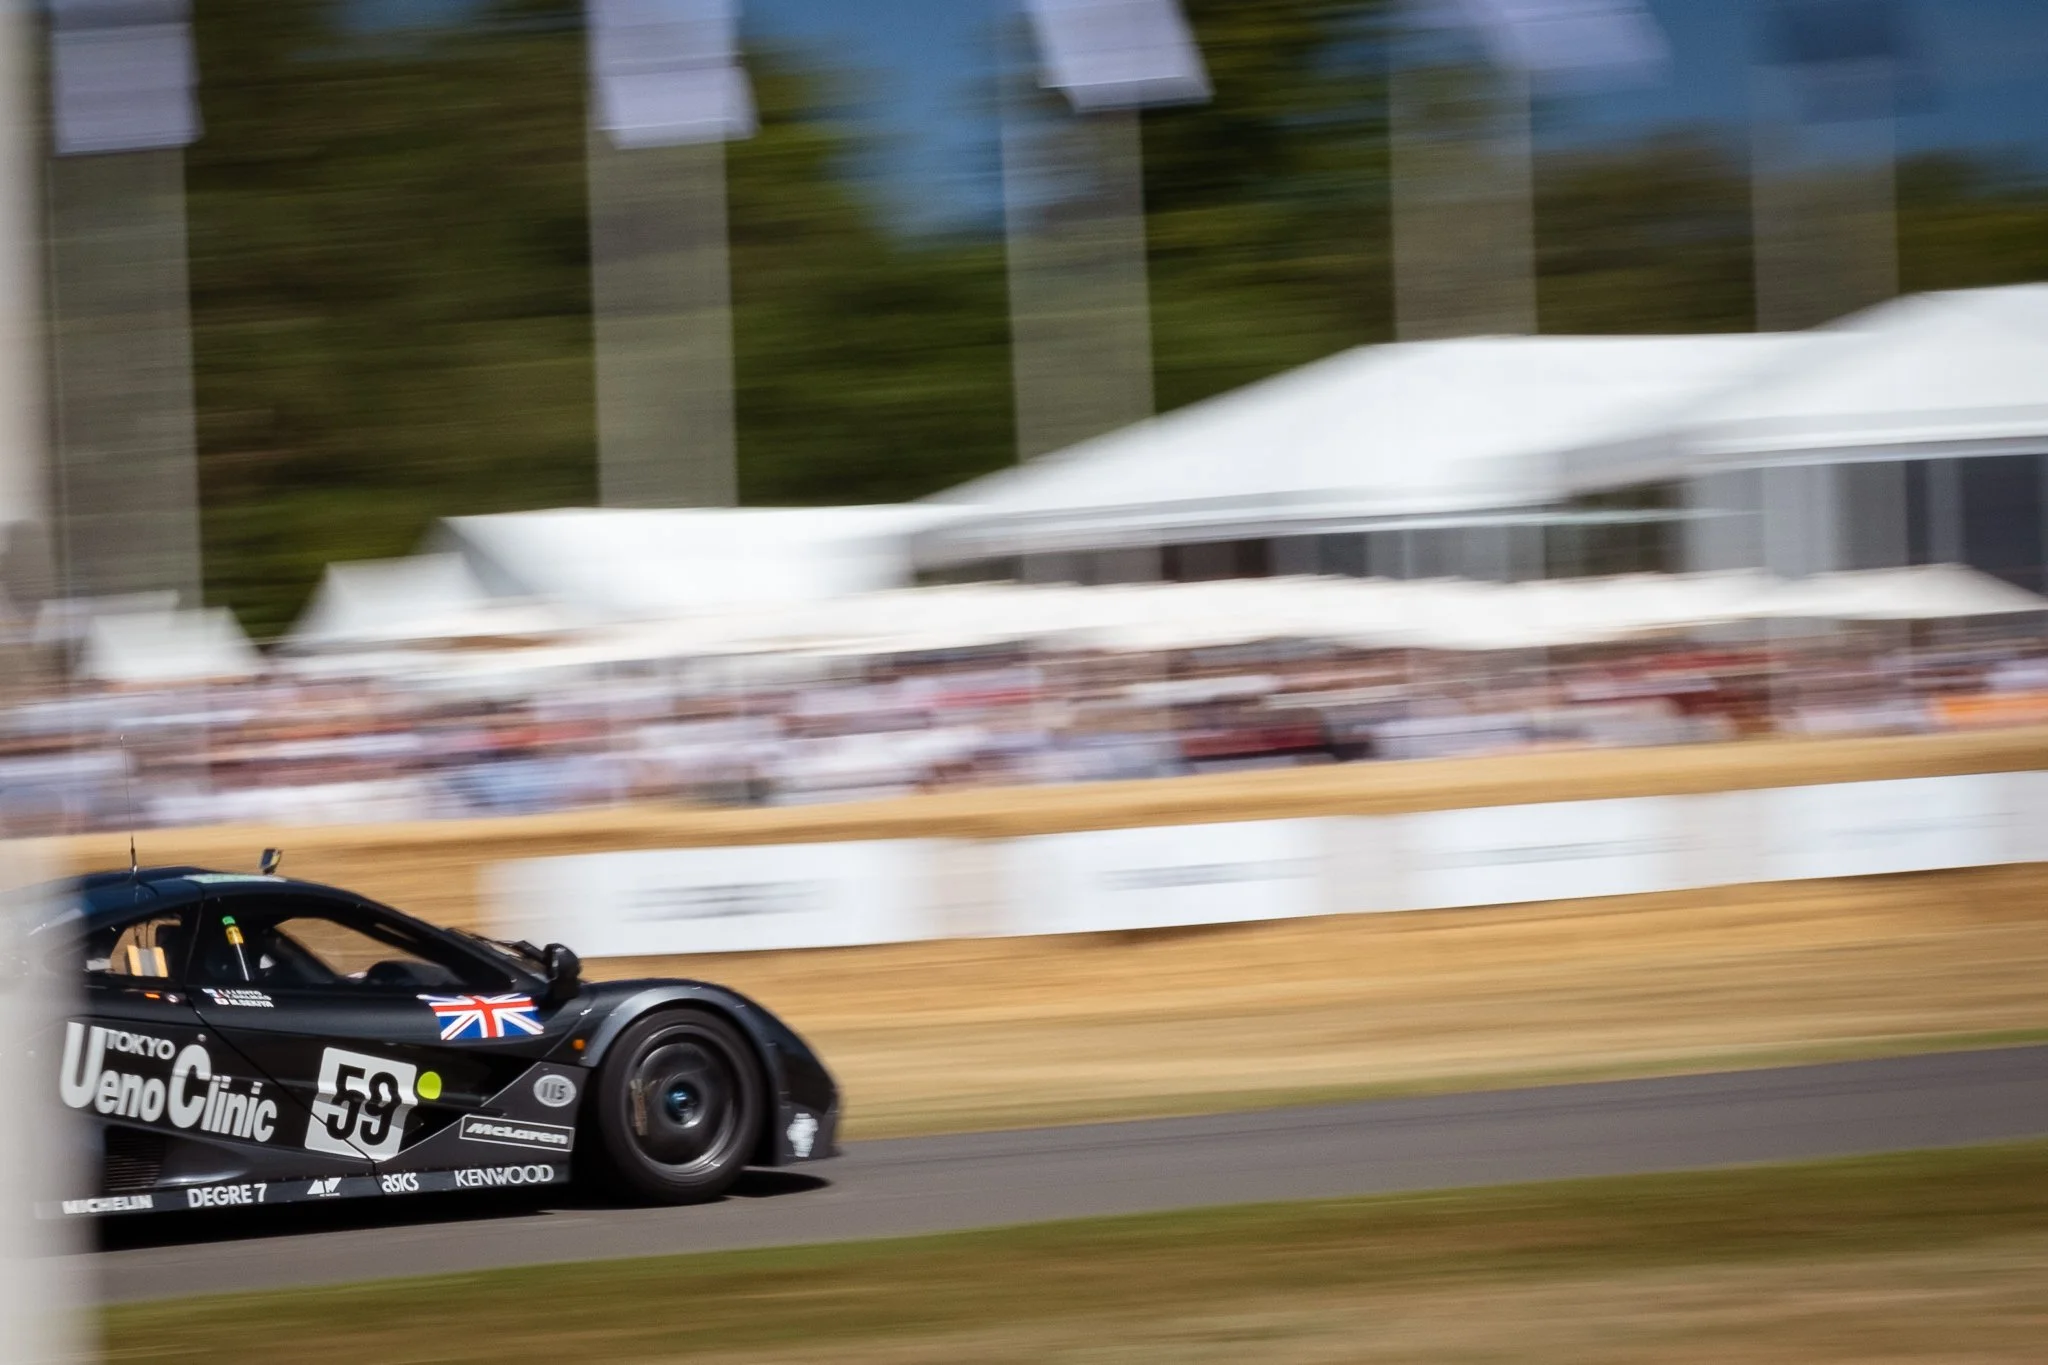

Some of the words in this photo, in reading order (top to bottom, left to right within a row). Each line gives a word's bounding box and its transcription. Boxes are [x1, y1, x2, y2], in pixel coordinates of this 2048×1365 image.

[106, 1028, 176, 1060] TOKYO
[60, 1021, 166, 1123] Ueno
[168, 1043, 278, 1142] Clinic
[326, 1063, 402, 1146] 59
[466, 1123, 568, 1145] McLaren
[454, 1164, 554, 1187] KENWOOD
[187, 1185, 253, 1208] DEGRE
[254, 1183, 268, 1203] 7
